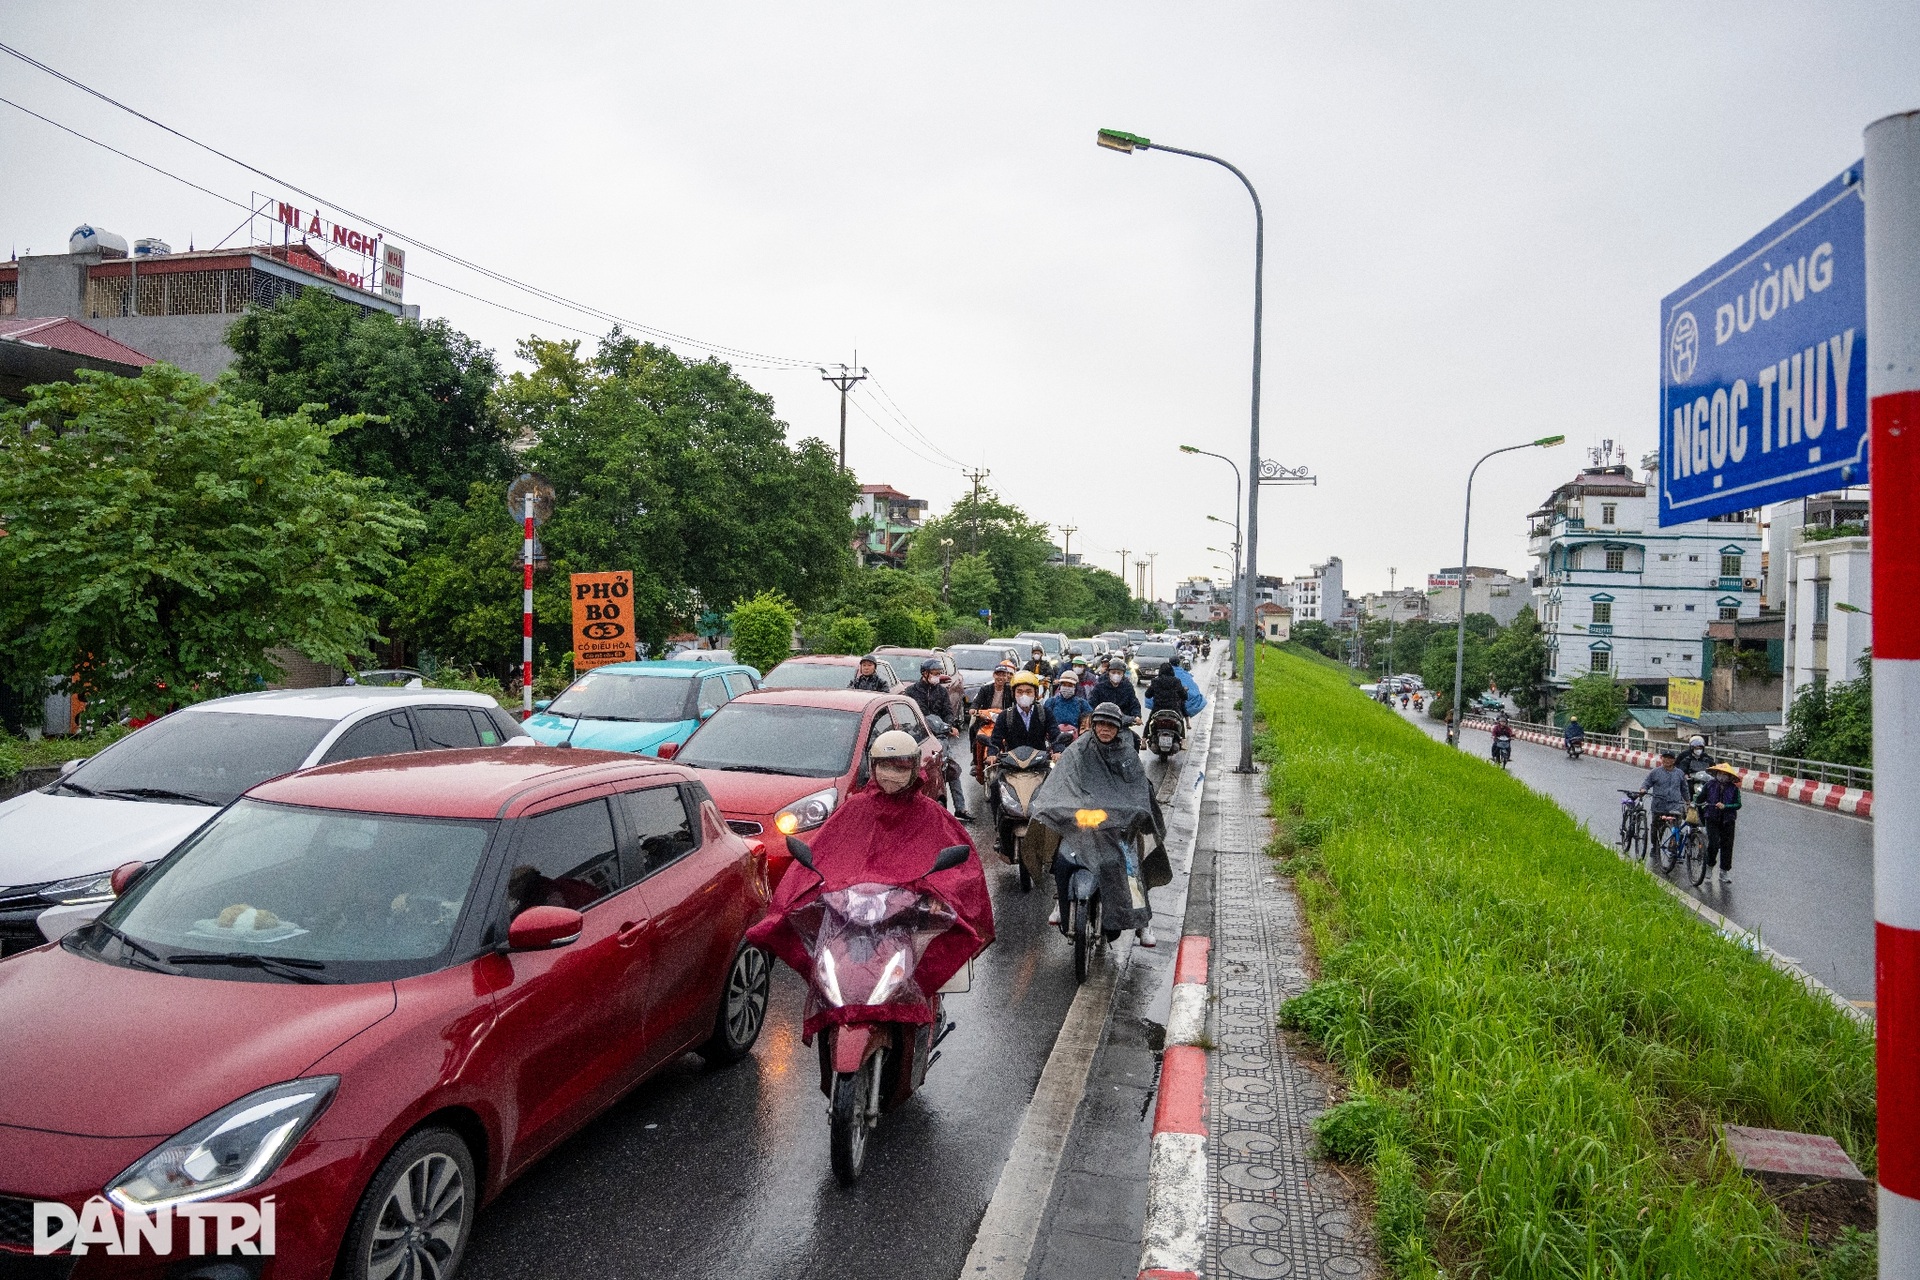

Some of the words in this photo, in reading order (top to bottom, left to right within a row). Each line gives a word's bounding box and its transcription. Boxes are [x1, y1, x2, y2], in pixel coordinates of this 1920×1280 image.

[387, 250, 403, 269] NHÀ
[1715, 241, 1834, 346] ĐƯỜNG
[1673, 378, 1749, 488] NGỌC
[1758, 327, 1855, 463] THỤY
[576, 575, 629, 600] PHỞ
[585, 599, 621, 621] BÒ
[578, 642, 590, 651] CÓ
